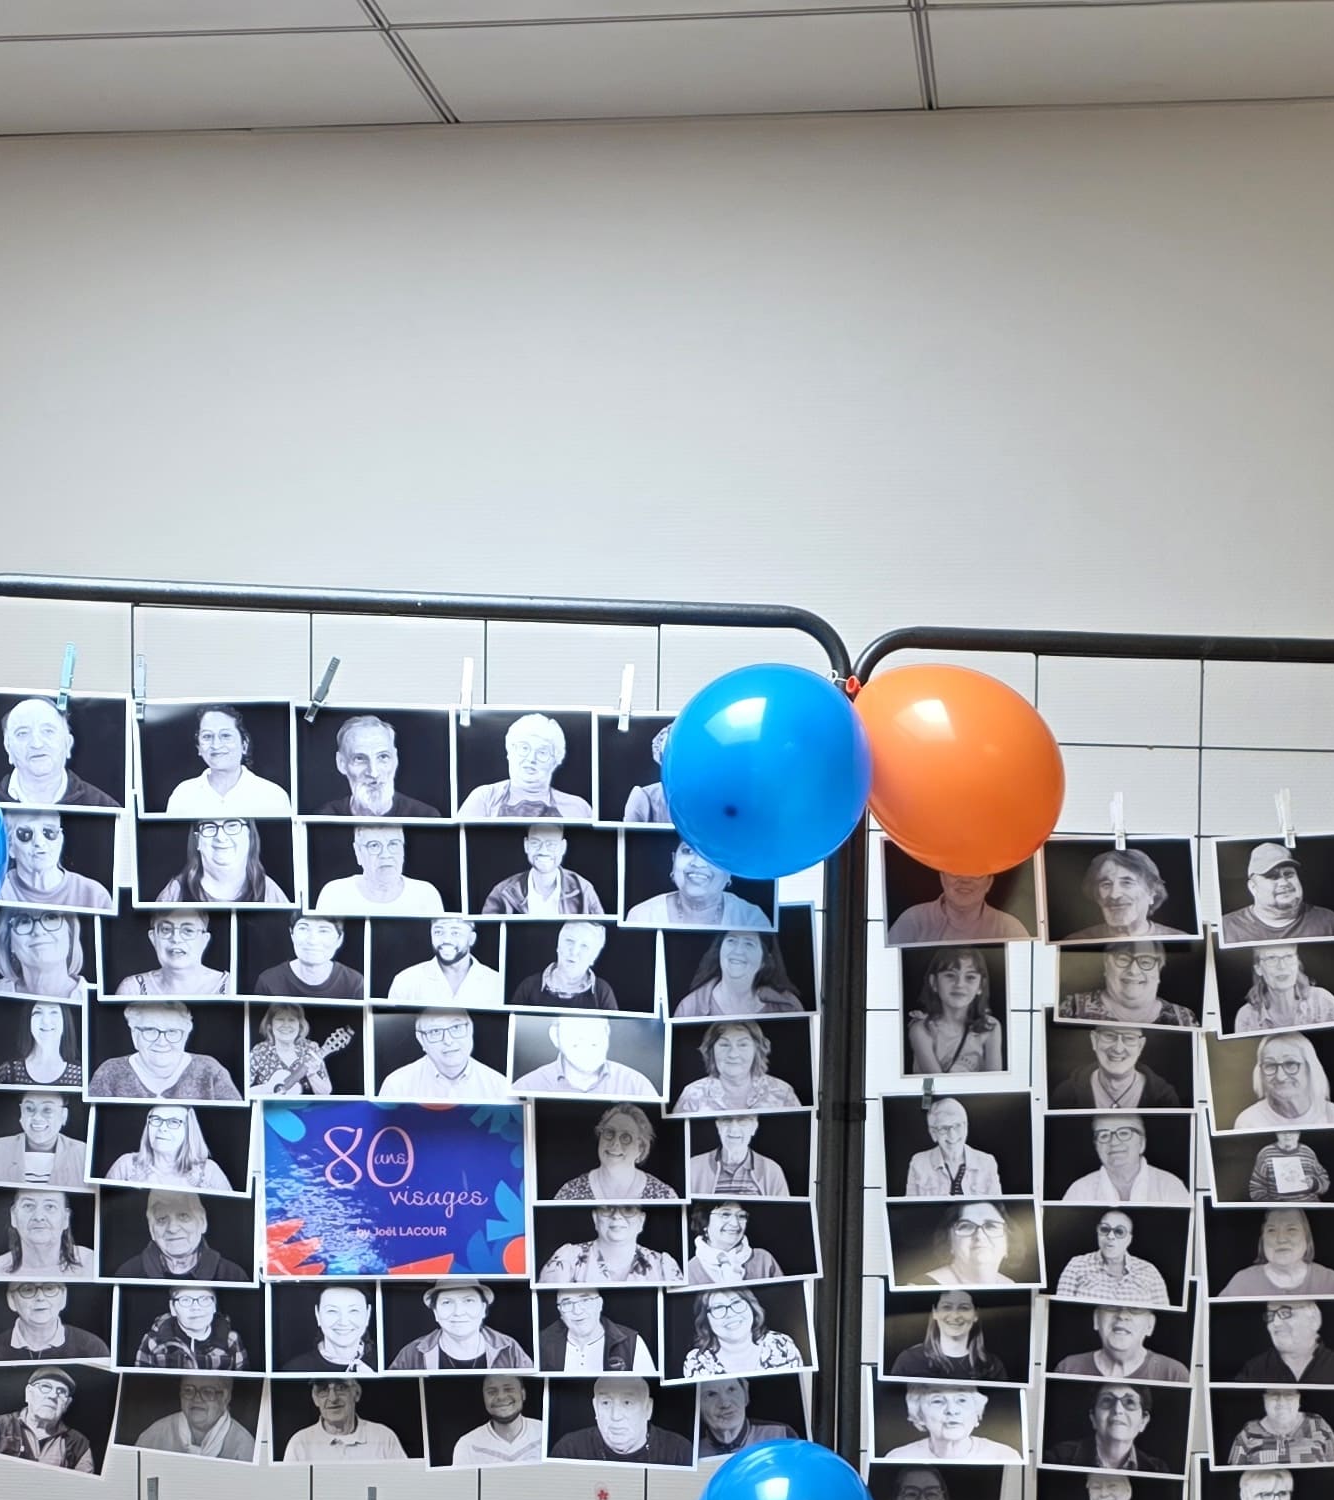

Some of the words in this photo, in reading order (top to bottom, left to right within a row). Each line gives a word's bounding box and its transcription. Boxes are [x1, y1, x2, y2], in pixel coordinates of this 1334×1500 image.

[323, 1126, 415, 1188] 80
[374, 1152, 410, 1164] ans
[389, 1186, 488, 1218] visages
[374, 1226, 396, 1236] Joël
[399, 1227, 447, 1237] LACOUR
